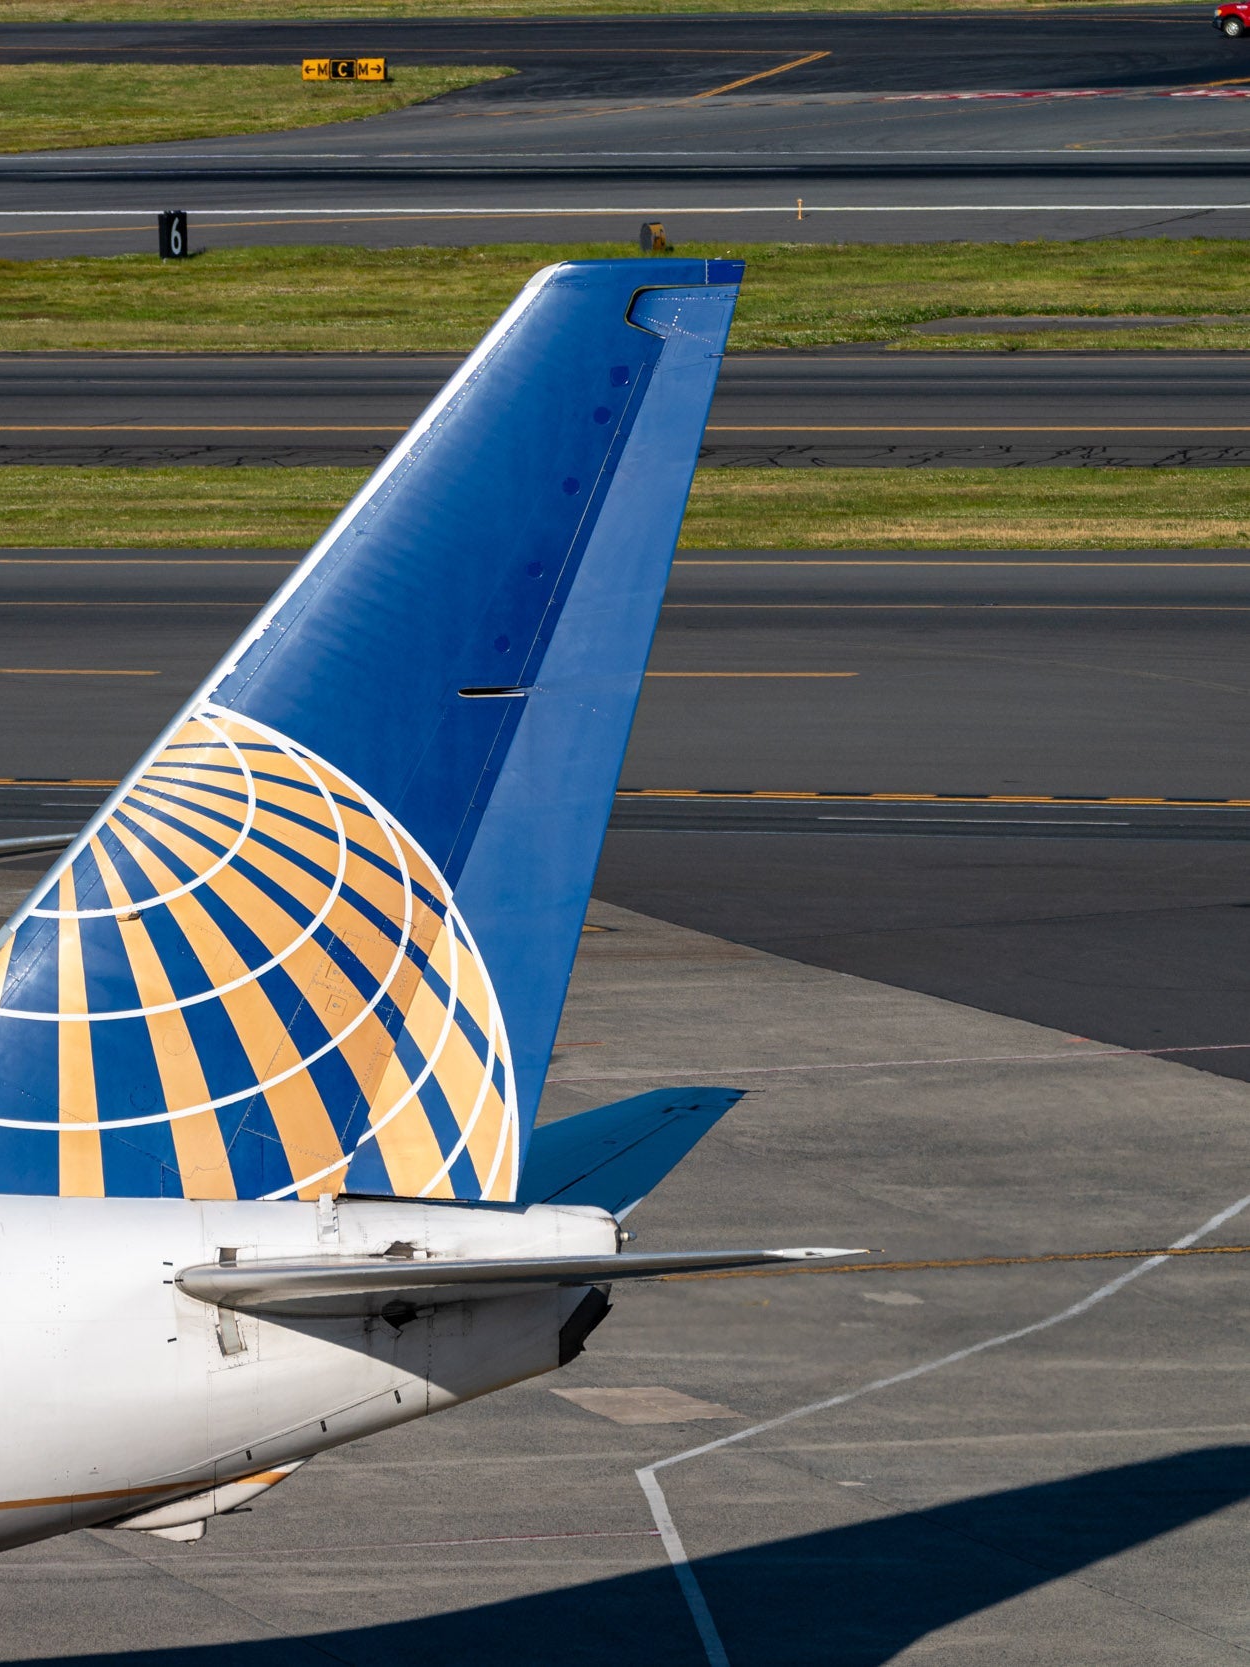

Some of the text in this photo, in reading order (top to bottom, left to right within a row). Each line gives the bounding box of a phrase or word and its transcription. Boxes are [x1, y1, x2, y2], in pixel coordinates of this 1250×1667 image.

[317, 62, 369, 77] M C M
[170, 216, 182, 256] 6
